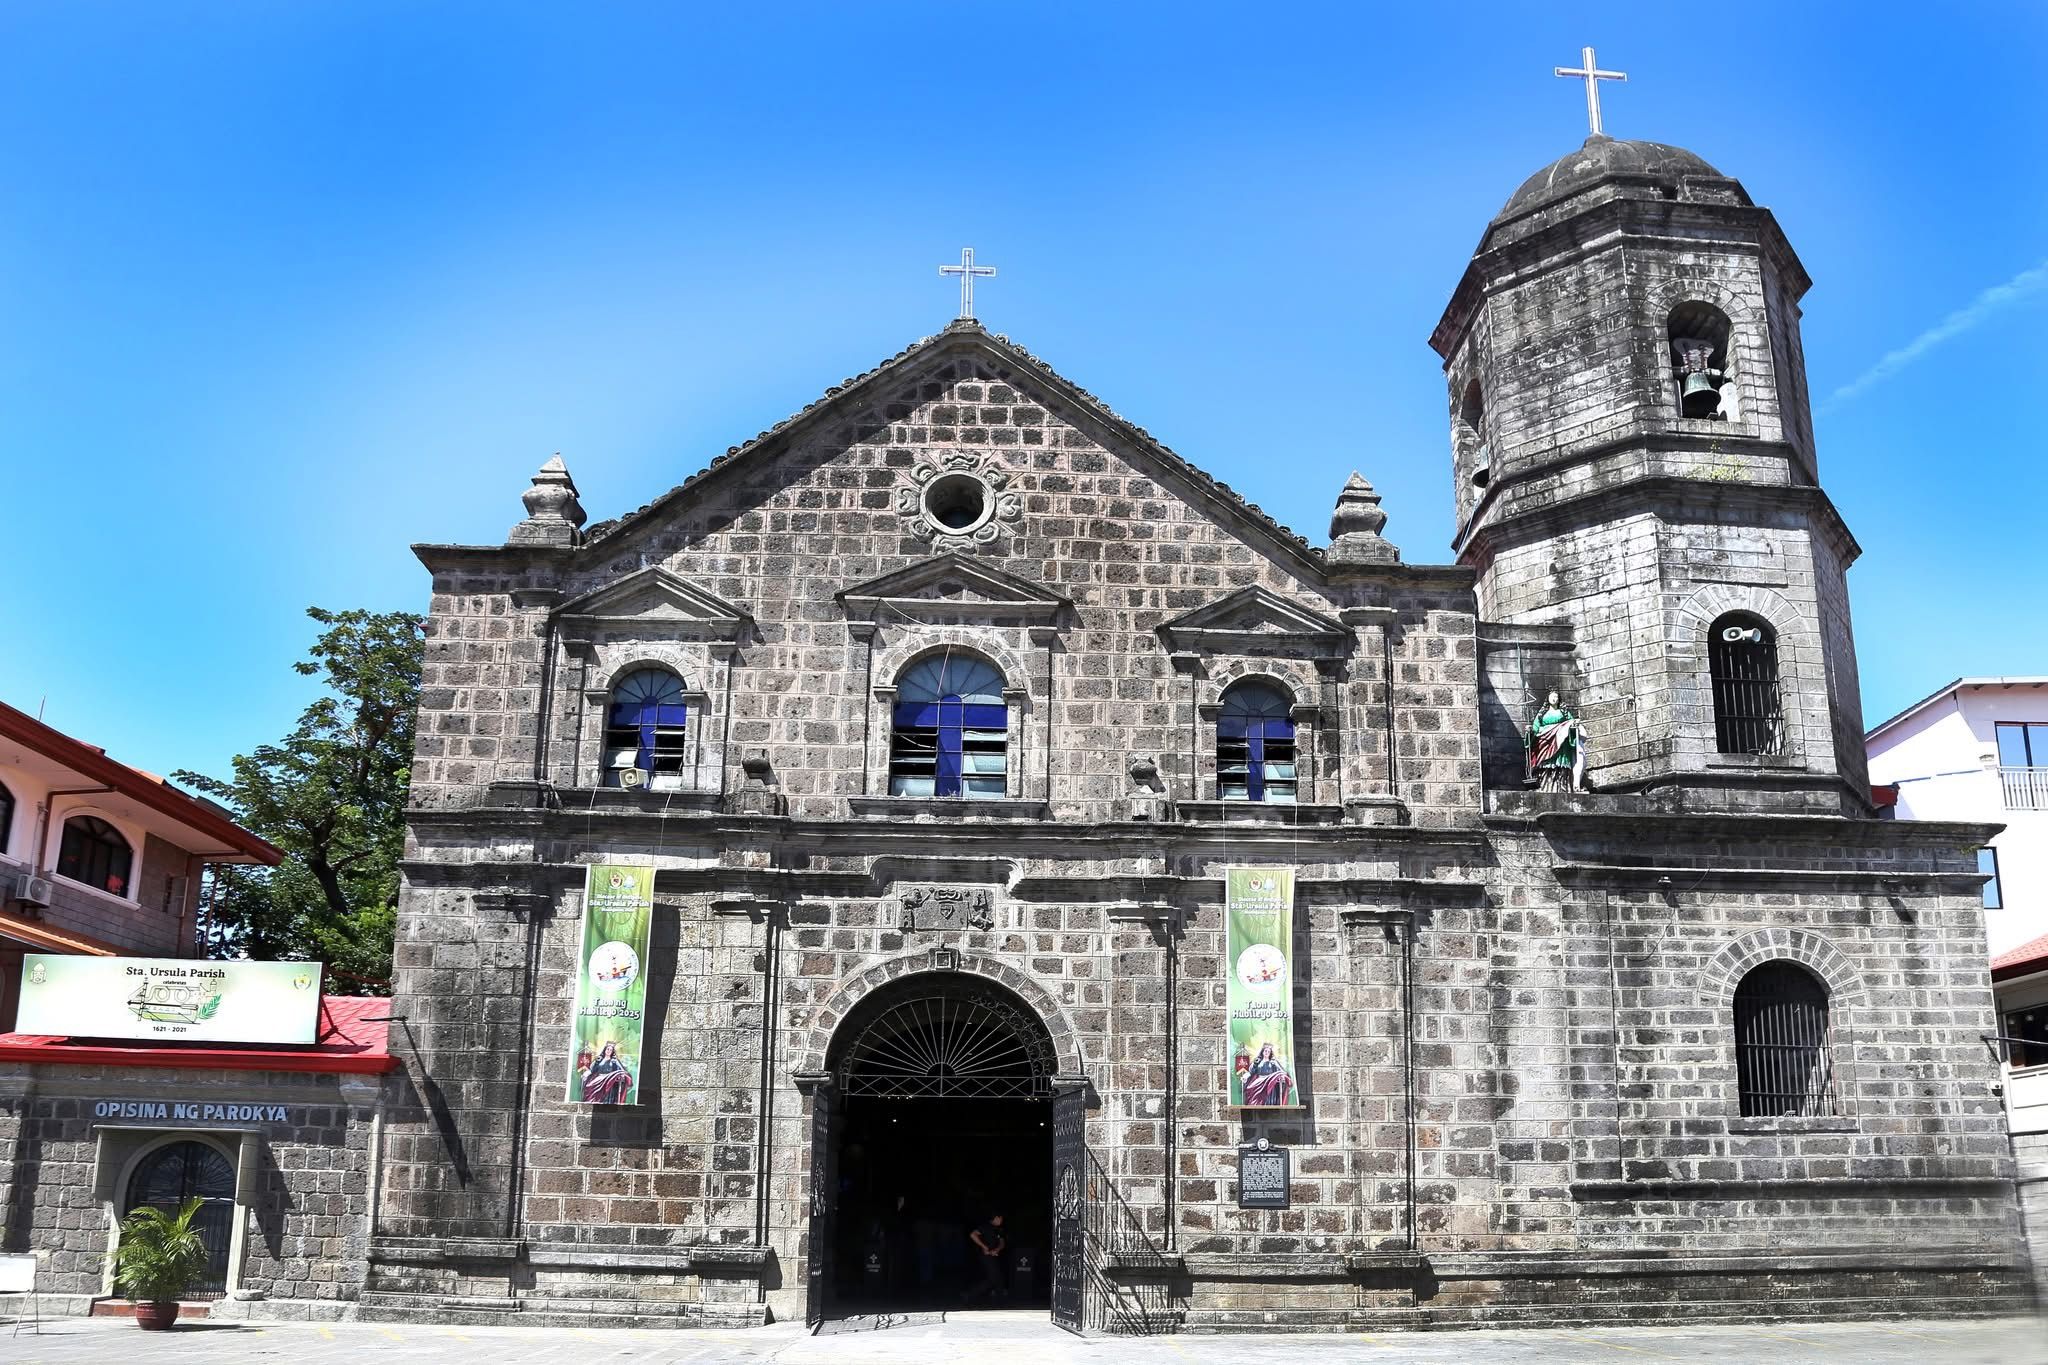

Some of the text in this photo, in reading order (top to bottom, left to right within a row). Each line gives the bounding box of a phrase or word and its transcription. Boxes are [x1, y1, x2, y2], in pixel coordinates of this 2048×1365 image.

[126, 966, 226, 979] Sta. Ursula Parish
[615, 999, 627, 1009] ng
[1268, 1002, 1281, 1011] ng
[618, 1009, 641, 1020] 2025
[95, 1102, 288, 1122] OPISINA NG PAROKYA
